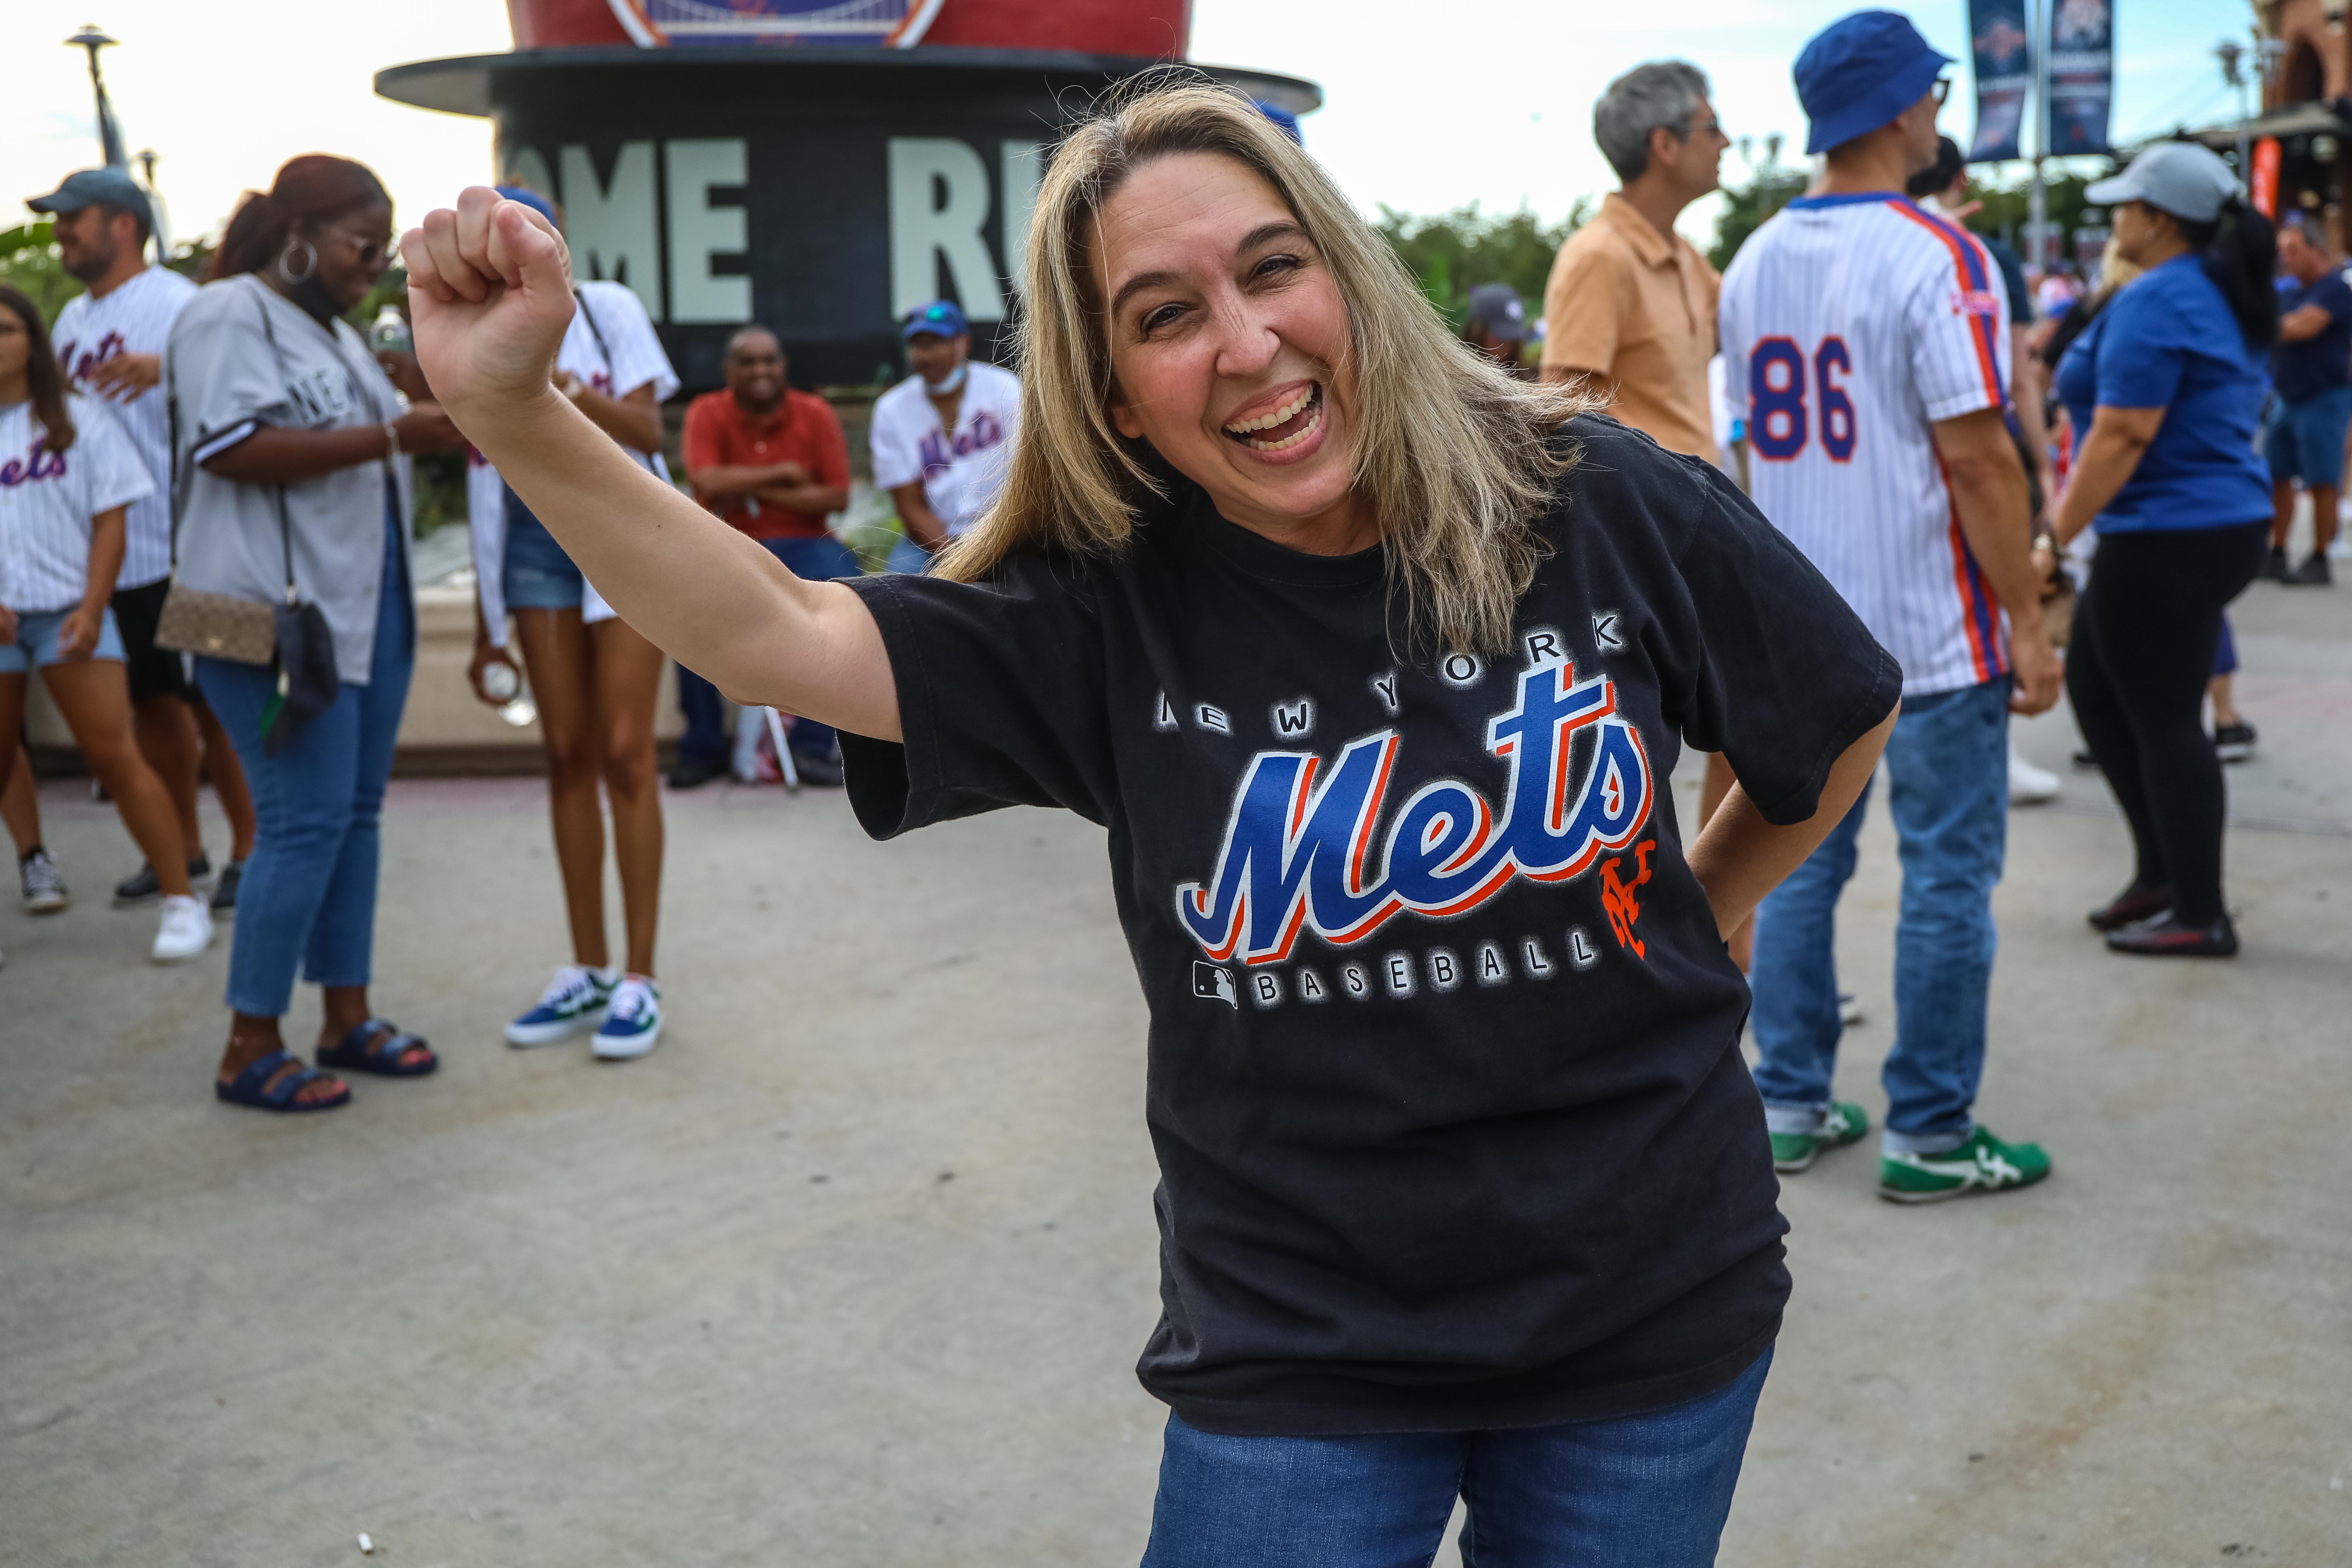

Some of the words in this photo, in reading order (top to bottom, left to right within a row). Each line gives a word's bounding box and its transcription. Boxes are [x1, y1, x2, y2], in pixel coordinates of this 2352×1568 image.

[1749, 335, 1857, 463] 86
[1373, 613, 1624, 708] YORK
[1176, 661, 1653, 965] Mets
[1256, 932, 1593, 1002] BASEBALL
